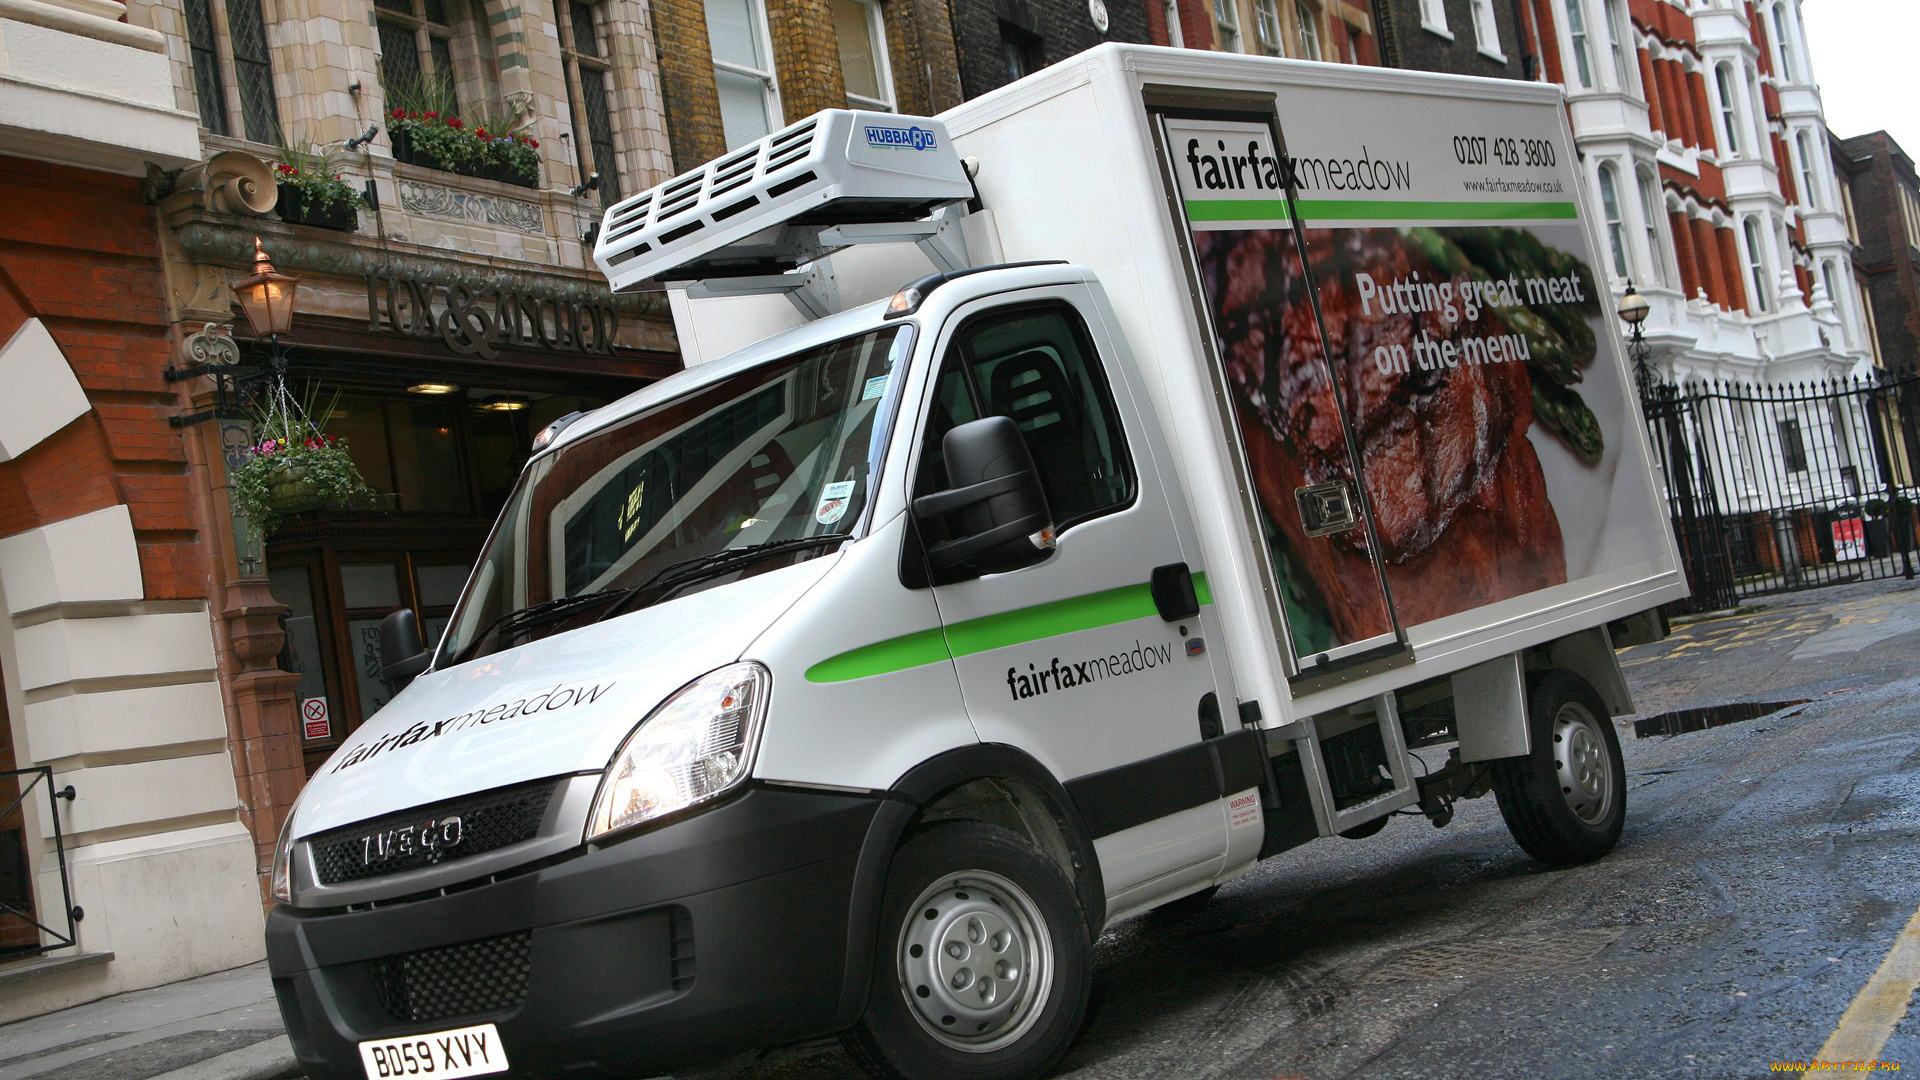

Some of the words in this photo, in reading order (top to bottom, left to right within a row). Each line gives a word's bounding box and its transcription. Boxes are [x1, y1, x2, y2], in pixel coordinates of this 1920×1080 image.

[866, 129, 934, 147] HUBBARD
[1453, 135, 1487, 165] 0207
[1494, 137, 1520, 166] 428
[1520, 138, 1556, 167] 3800
[1187, 138, 1411, 190] fairfaxmeadow
[1463, 177, 1564, 193] www.fairfaxmeadow.co.uk
[1355, 271, 1459, 323] Putting
[1460, 272, 1523, 321] great
[1525, 269, 1585, 305] meat
[1374, 342, 1411, 375] on
[1413, 329, 1458, 371] the
[1461, 332, 1531, 366] menu
[1007, 639, 1171, 701] fairfaxmeadow
[331, 681, 617, 774] fairfaxmeadow
[1230, 795, 1256, 809] WARNING
[362, 815, 463, 865] IVECO
[372, 1041, 435, 1078] BD59
[437, 1032, 490, 1071] XVY
